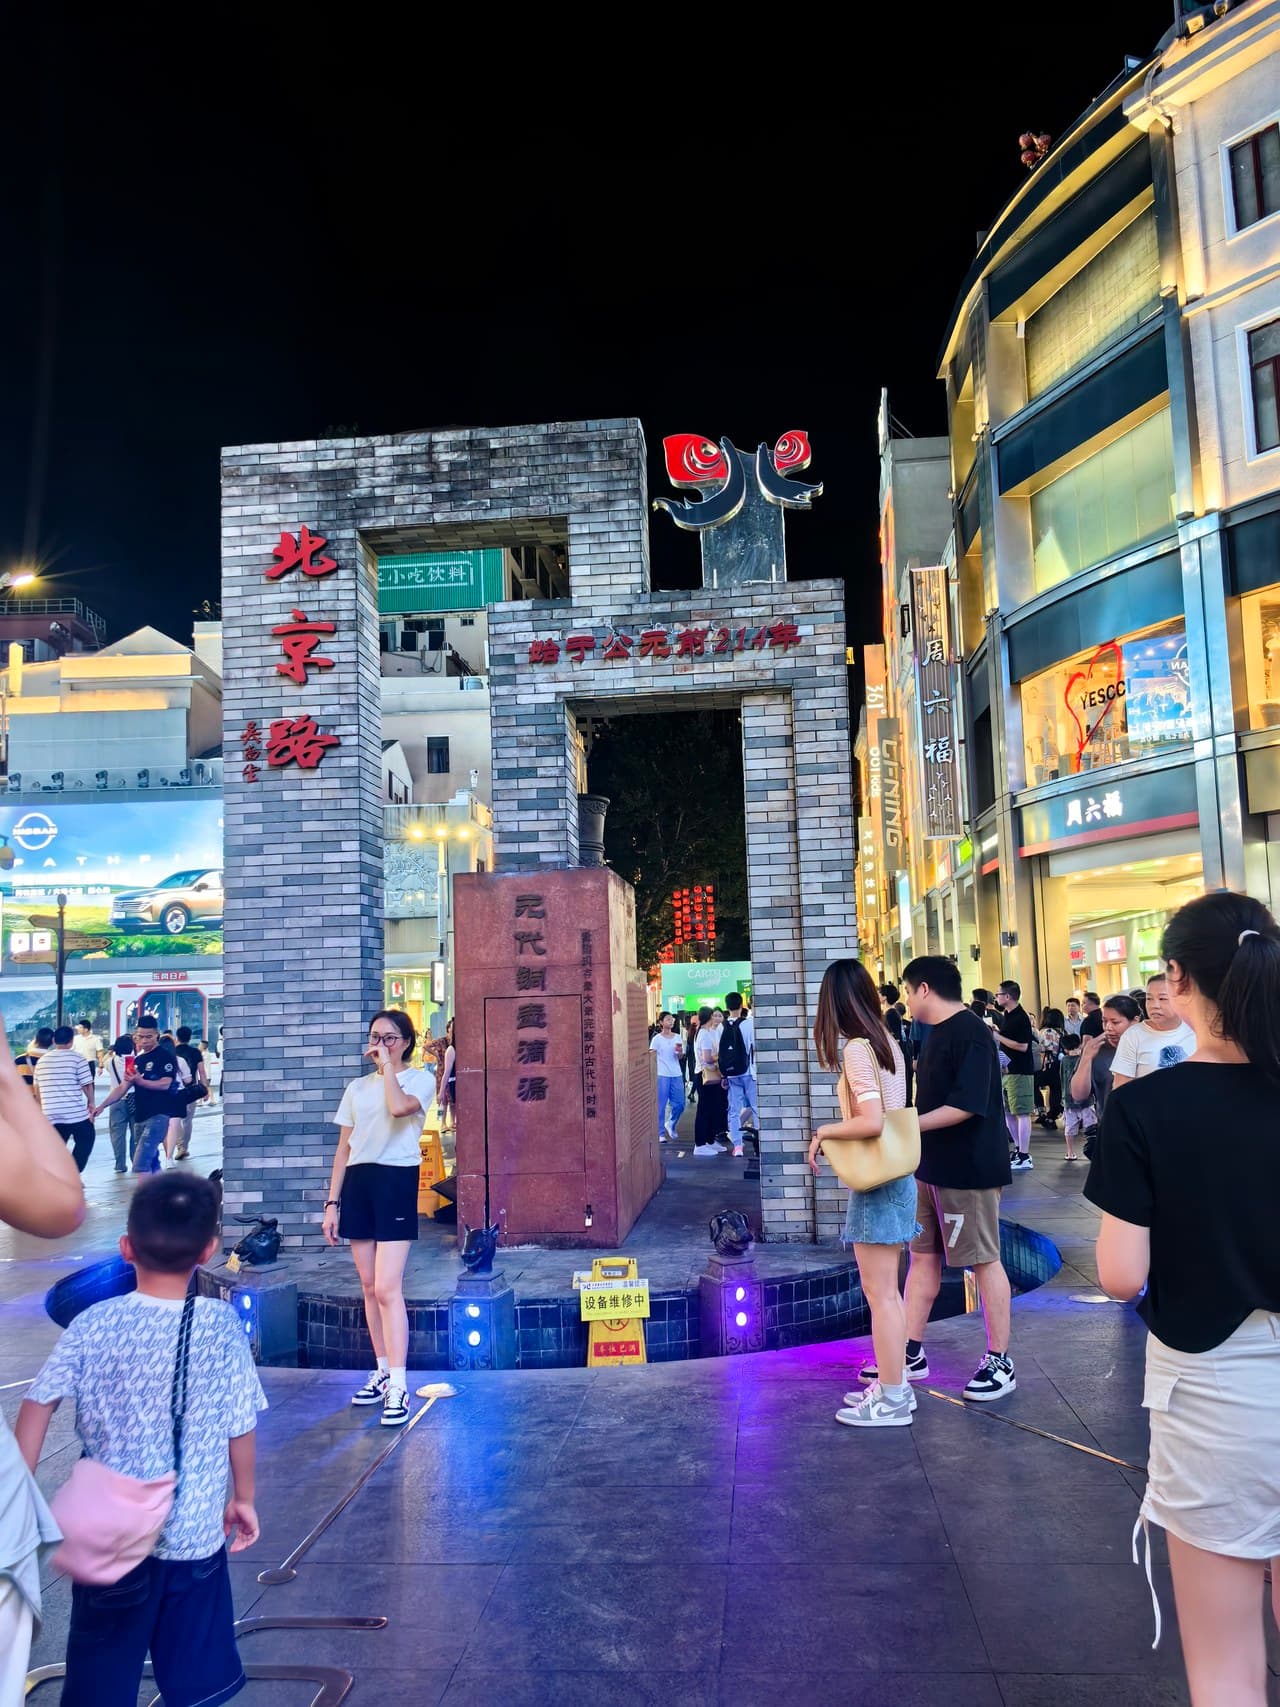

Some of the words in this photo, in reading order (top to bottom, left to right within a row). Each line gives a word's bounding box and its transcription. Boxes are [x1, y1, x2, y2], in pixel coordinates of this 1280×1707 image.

[265, 525, 340, 768] 北京路
[529, 622, 801, 664] 始于公元前214年
[922, 639, 953, 764] 周六福
[1066, 790, 1123, 827] 周六福
[687, 968, 731, 979] CARTELO
[944, 1213, 965, 1248] 7
[585, 1293, 645, 1310] 设备维修中
